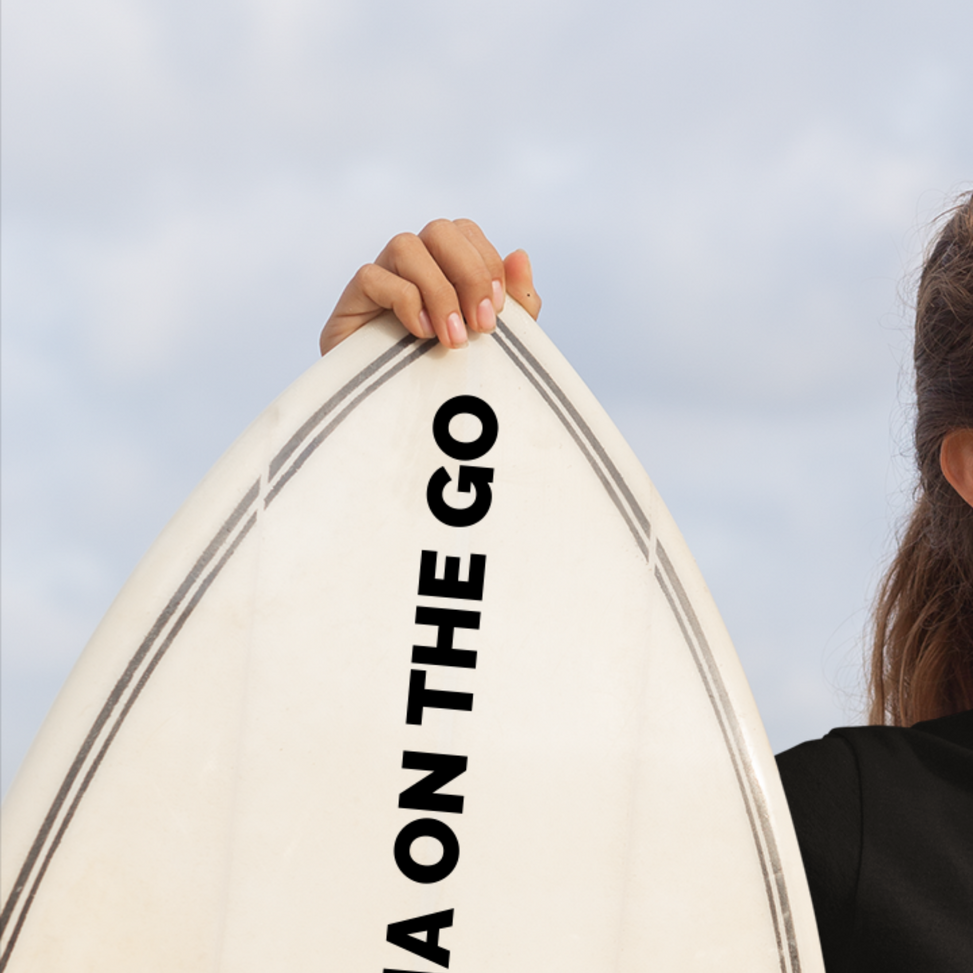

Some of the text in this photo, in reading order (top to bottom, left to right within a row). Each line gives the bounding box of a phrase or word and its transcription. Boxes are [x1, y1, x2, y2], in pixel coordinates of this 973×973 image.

[427, 395, 499, 528] GO
[405, 550, 487, 726] THE
[394, 751, 468, 884] ON
